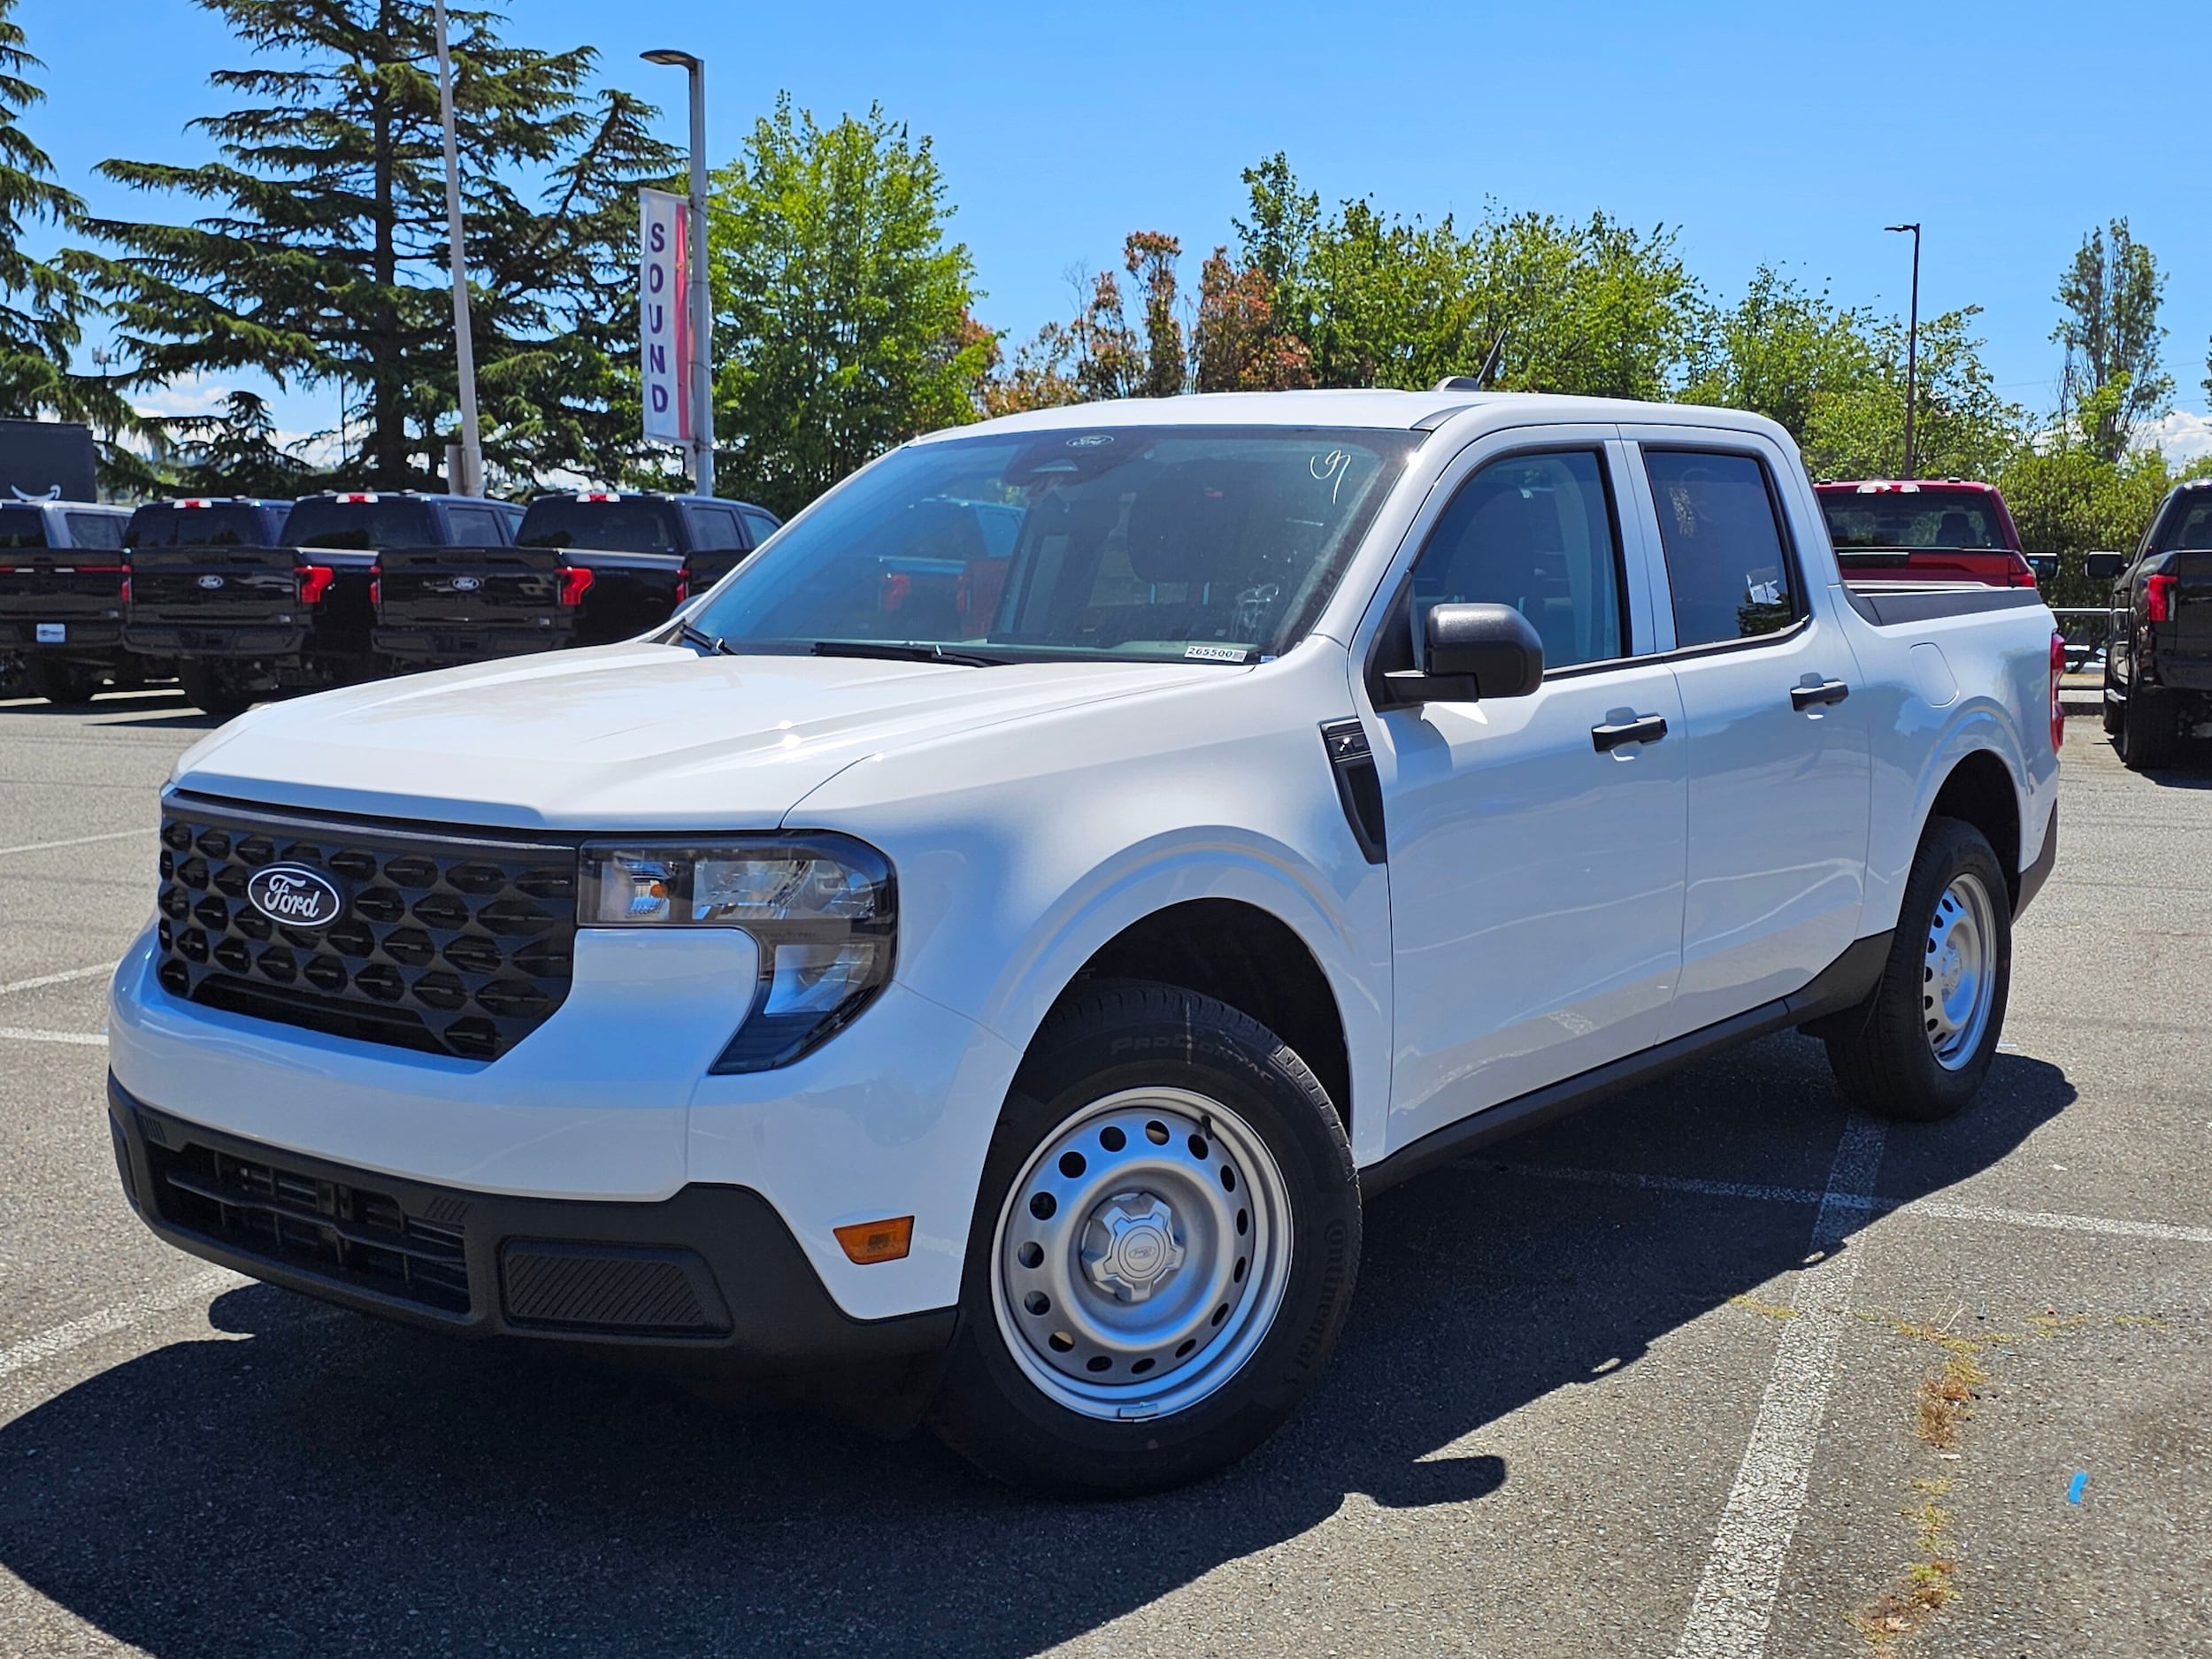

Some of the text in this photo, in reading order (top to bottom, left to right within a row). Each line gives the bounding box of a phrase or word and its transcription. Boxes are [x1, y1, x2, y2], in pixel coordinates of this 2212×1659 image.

[648, 222, 669, 413] SOUND
[1187, 648, 1233, 658] 265500
[264, 874, 320, 918] Ford
